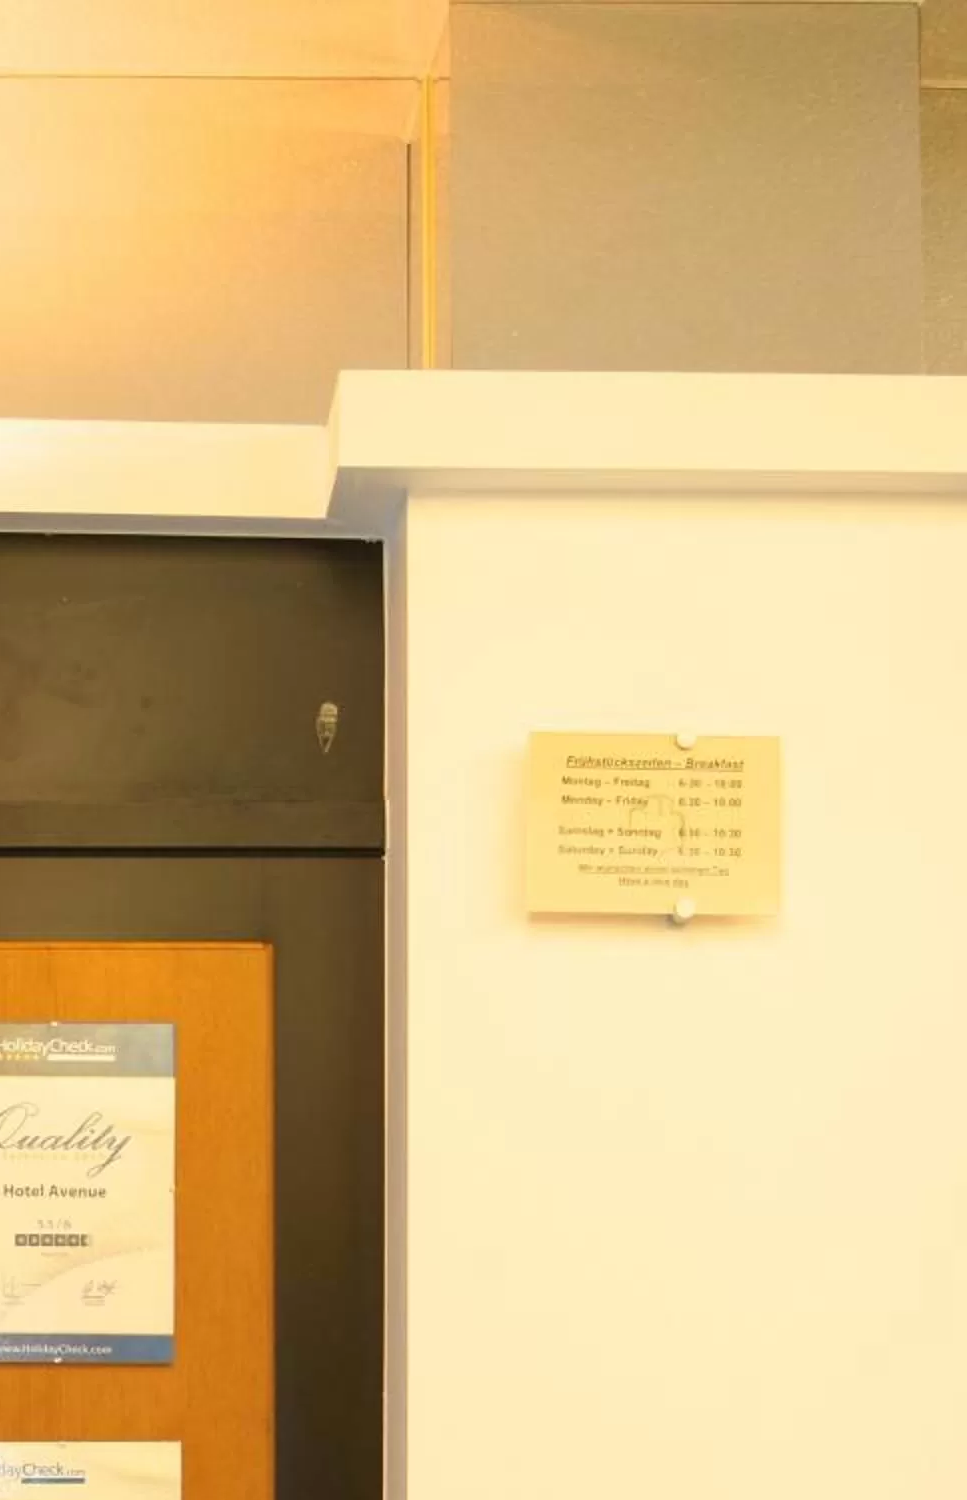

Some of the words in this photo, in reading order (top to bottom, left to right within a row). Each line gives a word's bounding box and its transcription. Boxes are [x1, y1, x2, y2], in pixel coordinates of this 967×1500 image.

[685, 757, 744, 769] Breakfast
[561, 776, 601, 788] Montag
[613, 777, 650, 789] Freitag
[561, 795, 603, 807] Monday
[615, 796, 649, 807] Friday
[3, 1184, 44, 1199] Hotel
[49, 1185, 107, 1199] Avenue
